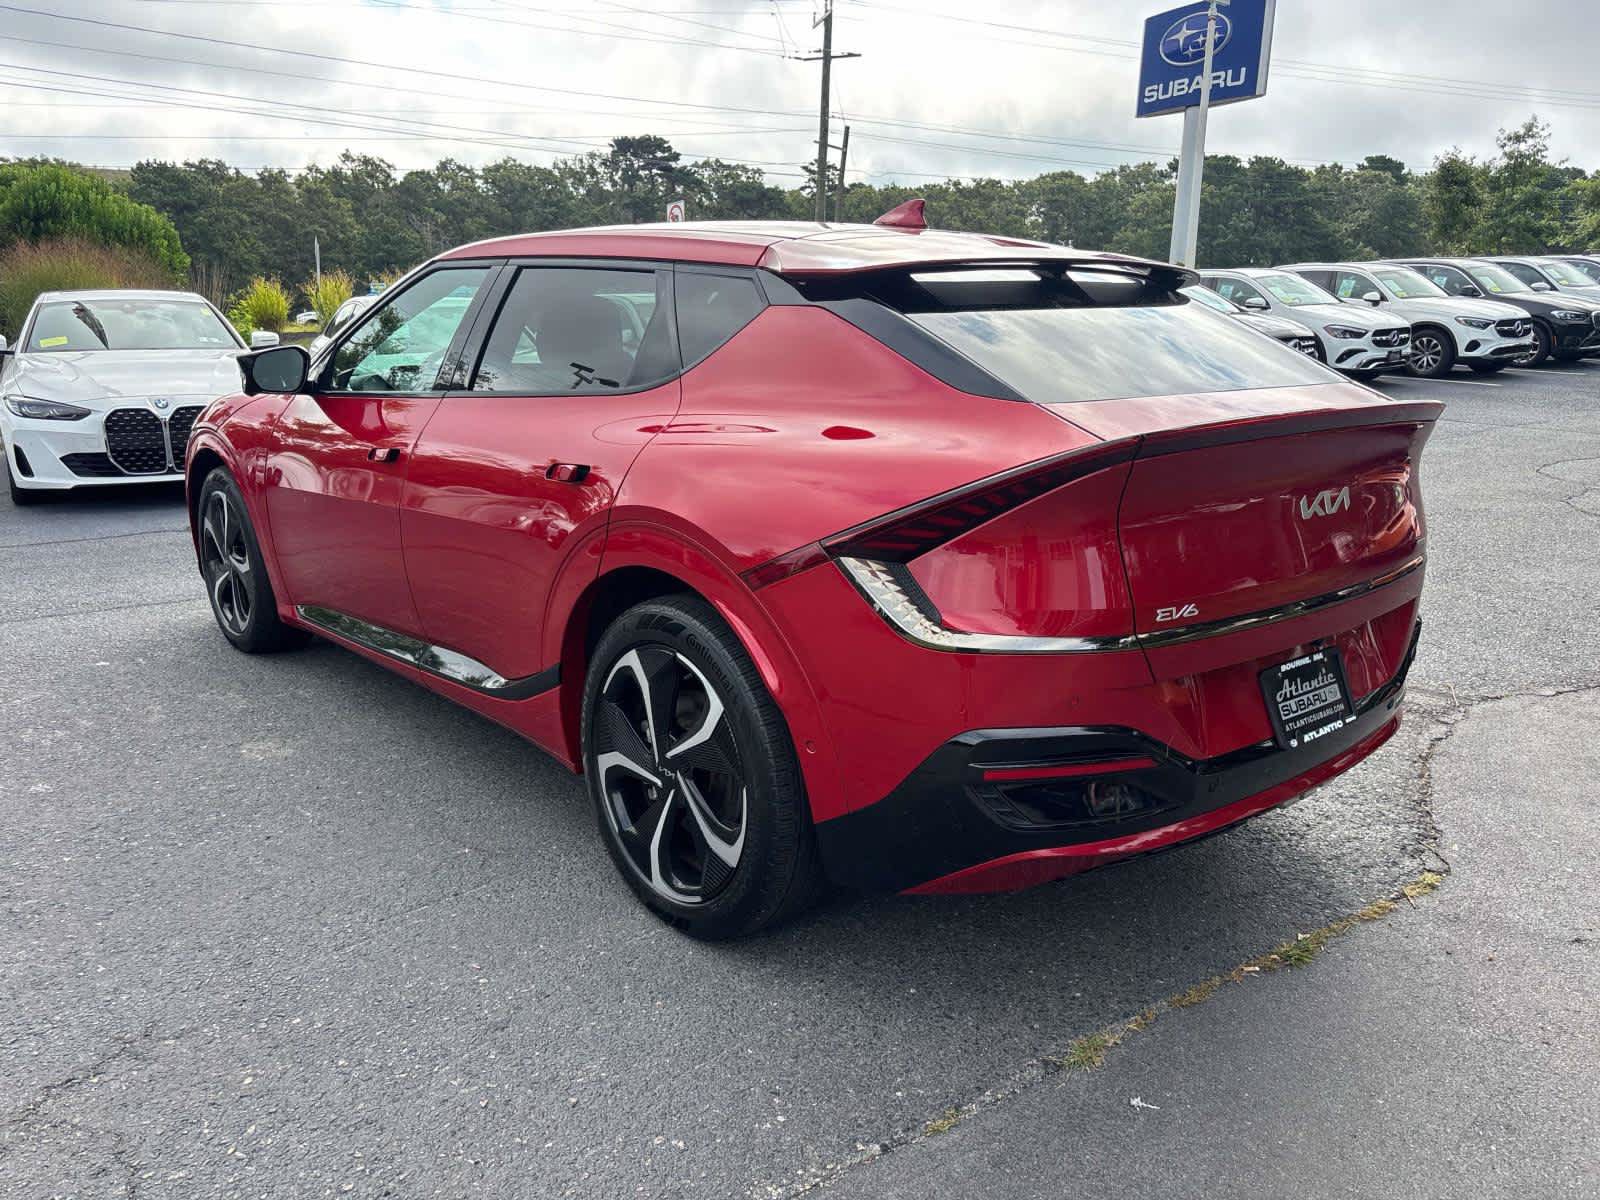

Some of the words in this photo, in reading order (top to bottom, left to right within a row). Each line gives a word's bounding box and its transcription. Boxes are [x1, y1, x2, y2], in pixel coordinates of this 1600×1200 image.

[1143, 67, 1247, 104] SUBARU
[1299, 486, 1351, 520] KIA
[1155, 602, 1200, 623] EV6
[1276, 668, 1337, 703] Atlantic
[1280, 689, 1328, 718] SUBARU
